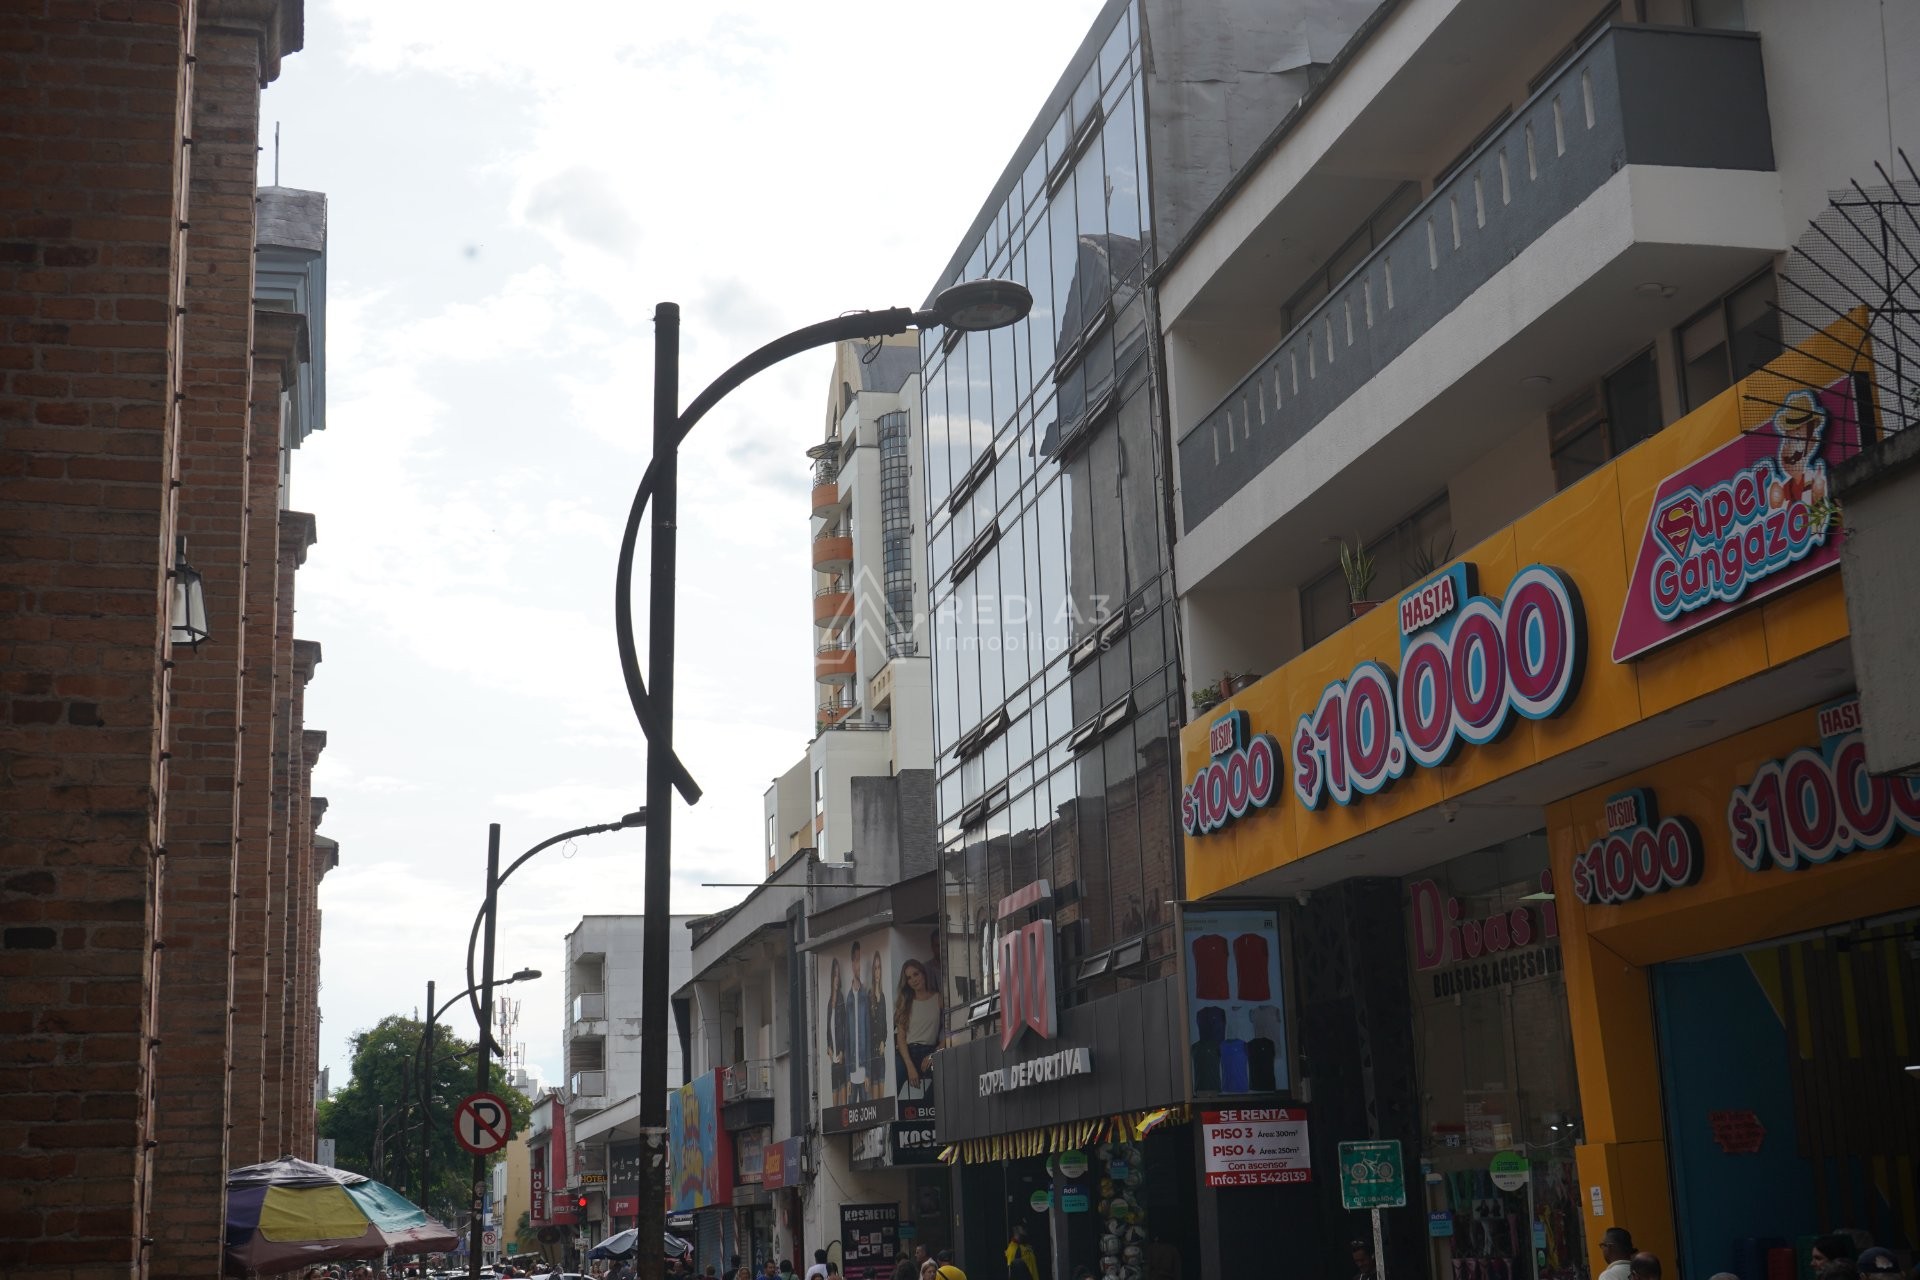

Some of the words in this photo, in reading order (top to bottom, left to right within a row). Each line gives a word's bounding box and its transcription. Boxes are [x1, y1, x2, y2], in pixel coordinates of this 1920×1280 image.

[1655, 466, 1769, 560] Super
[1654, 502, 1810, 607] Gangazo
[1401, 578, 1454, 632] HASTA
[1296, 580, 1569, 799] $10.000
[1210, 719, 1233, 755] DESDE
[1606, 797, 1637, 830] DESDE
[1409, 879, 1531, 971] Divas
[979, 1068, 1005, 1097] ROPA
[1010, 1048, 1086, 1091] DEPORTIVA
[848, 1109, 859, 1124] BIG
[859, 1106, 877, 1121] JOHN
[917, 1107, 935, 1117] BIG
[1219, 1110, 1238, 1122] SE
[1240, 1108, 1290, 1120] RENTA
[1211, 1128, 1243, 1139] PISO
[1245, 1127, 1253, 1138] 3
[1212, 1145, 1244, 1156] PISO
[1246, 1145, 1256, 1155] 4
[1210, 1174, 1238, 1185] Info:
[1239, 1173, 1258, 1183] 315
[1260, 1171, 1307, 1183] 5428139
[1228, 1162, 1246, 1170] Con
[1248, 1161, 1288, 1170] ascensor
[581, 1174, 608, 1183] HOTEL
[533, 1171, 542, 1219] HOTEL
[844, 1208, 897, 1222] KOSMETIC
